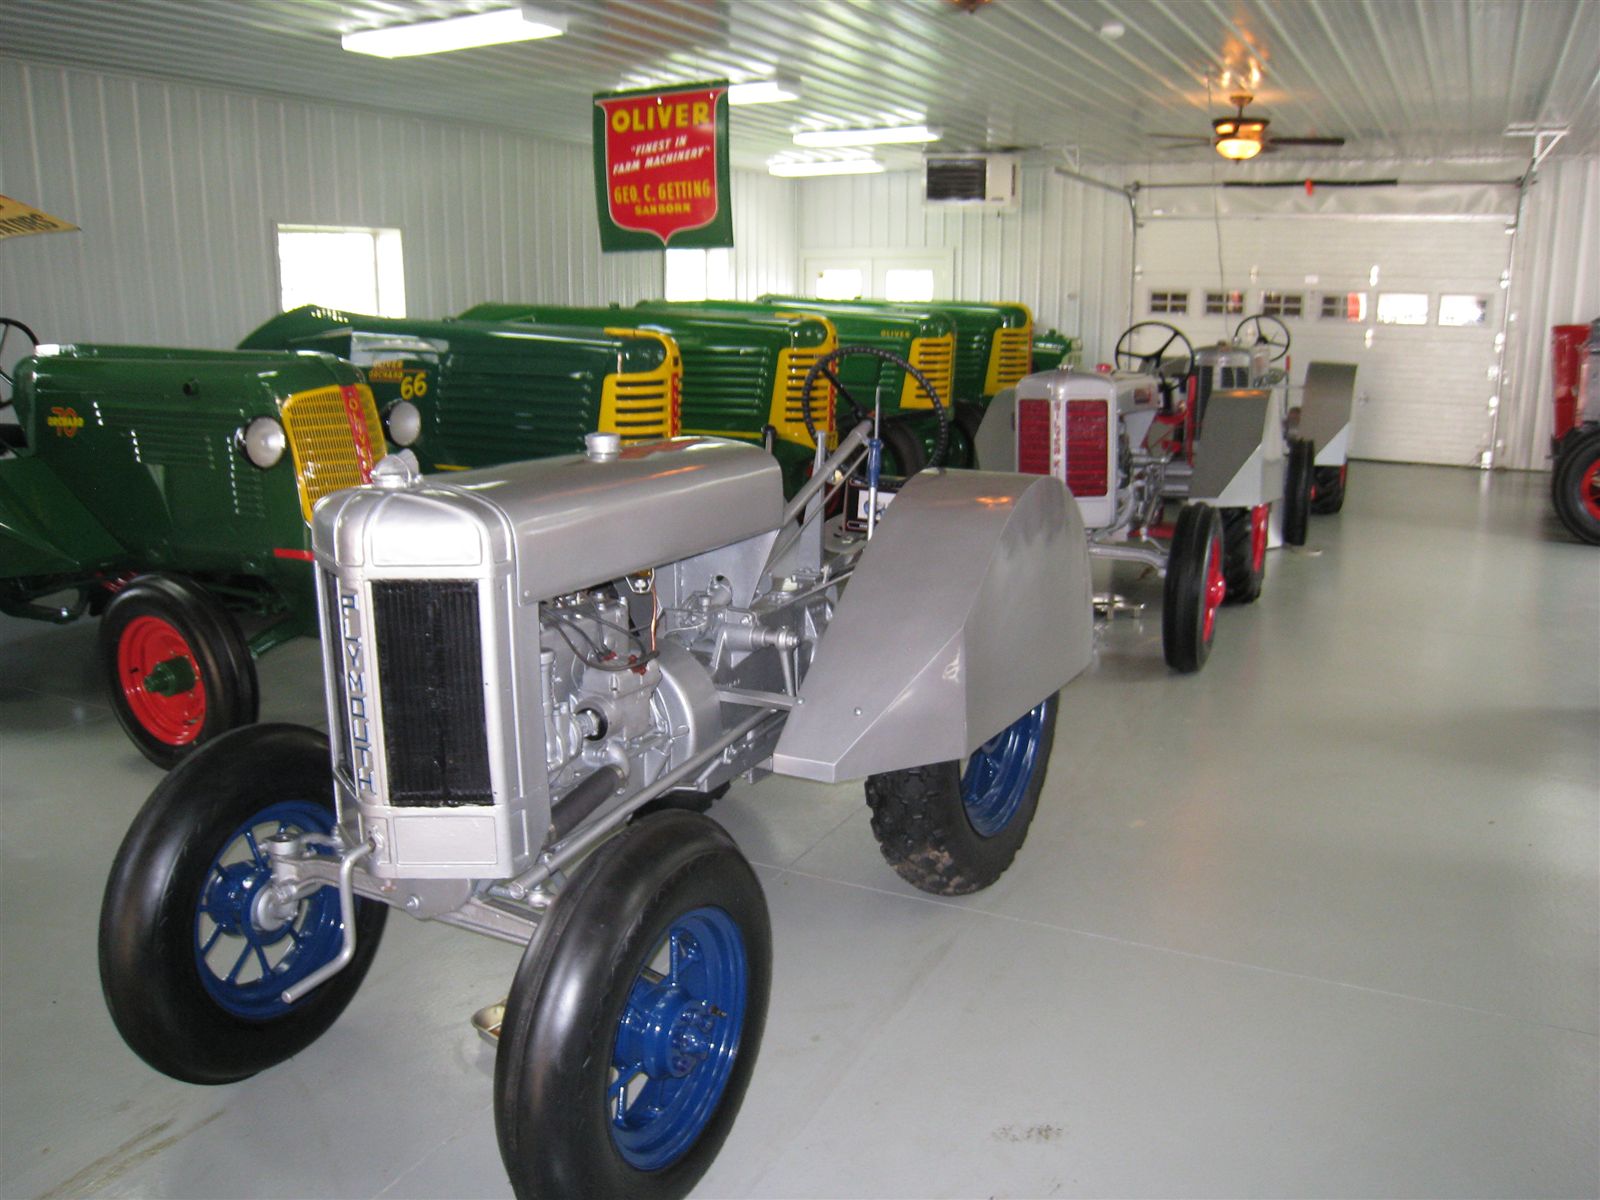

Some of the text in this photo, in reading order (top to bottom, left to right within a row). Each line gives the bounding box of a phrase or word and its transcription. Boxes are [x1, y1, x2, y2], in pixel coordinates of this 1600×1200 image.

[611, 102, 709, 133] OLIVER
[675, 135, 688, 147] IN
[613, 159, 641, 177] FARM
[658, 178, 711, 200] GETTING
[400, 372, 428, 400] 66
[342, 594, 377, 796] PLYMOUTH
